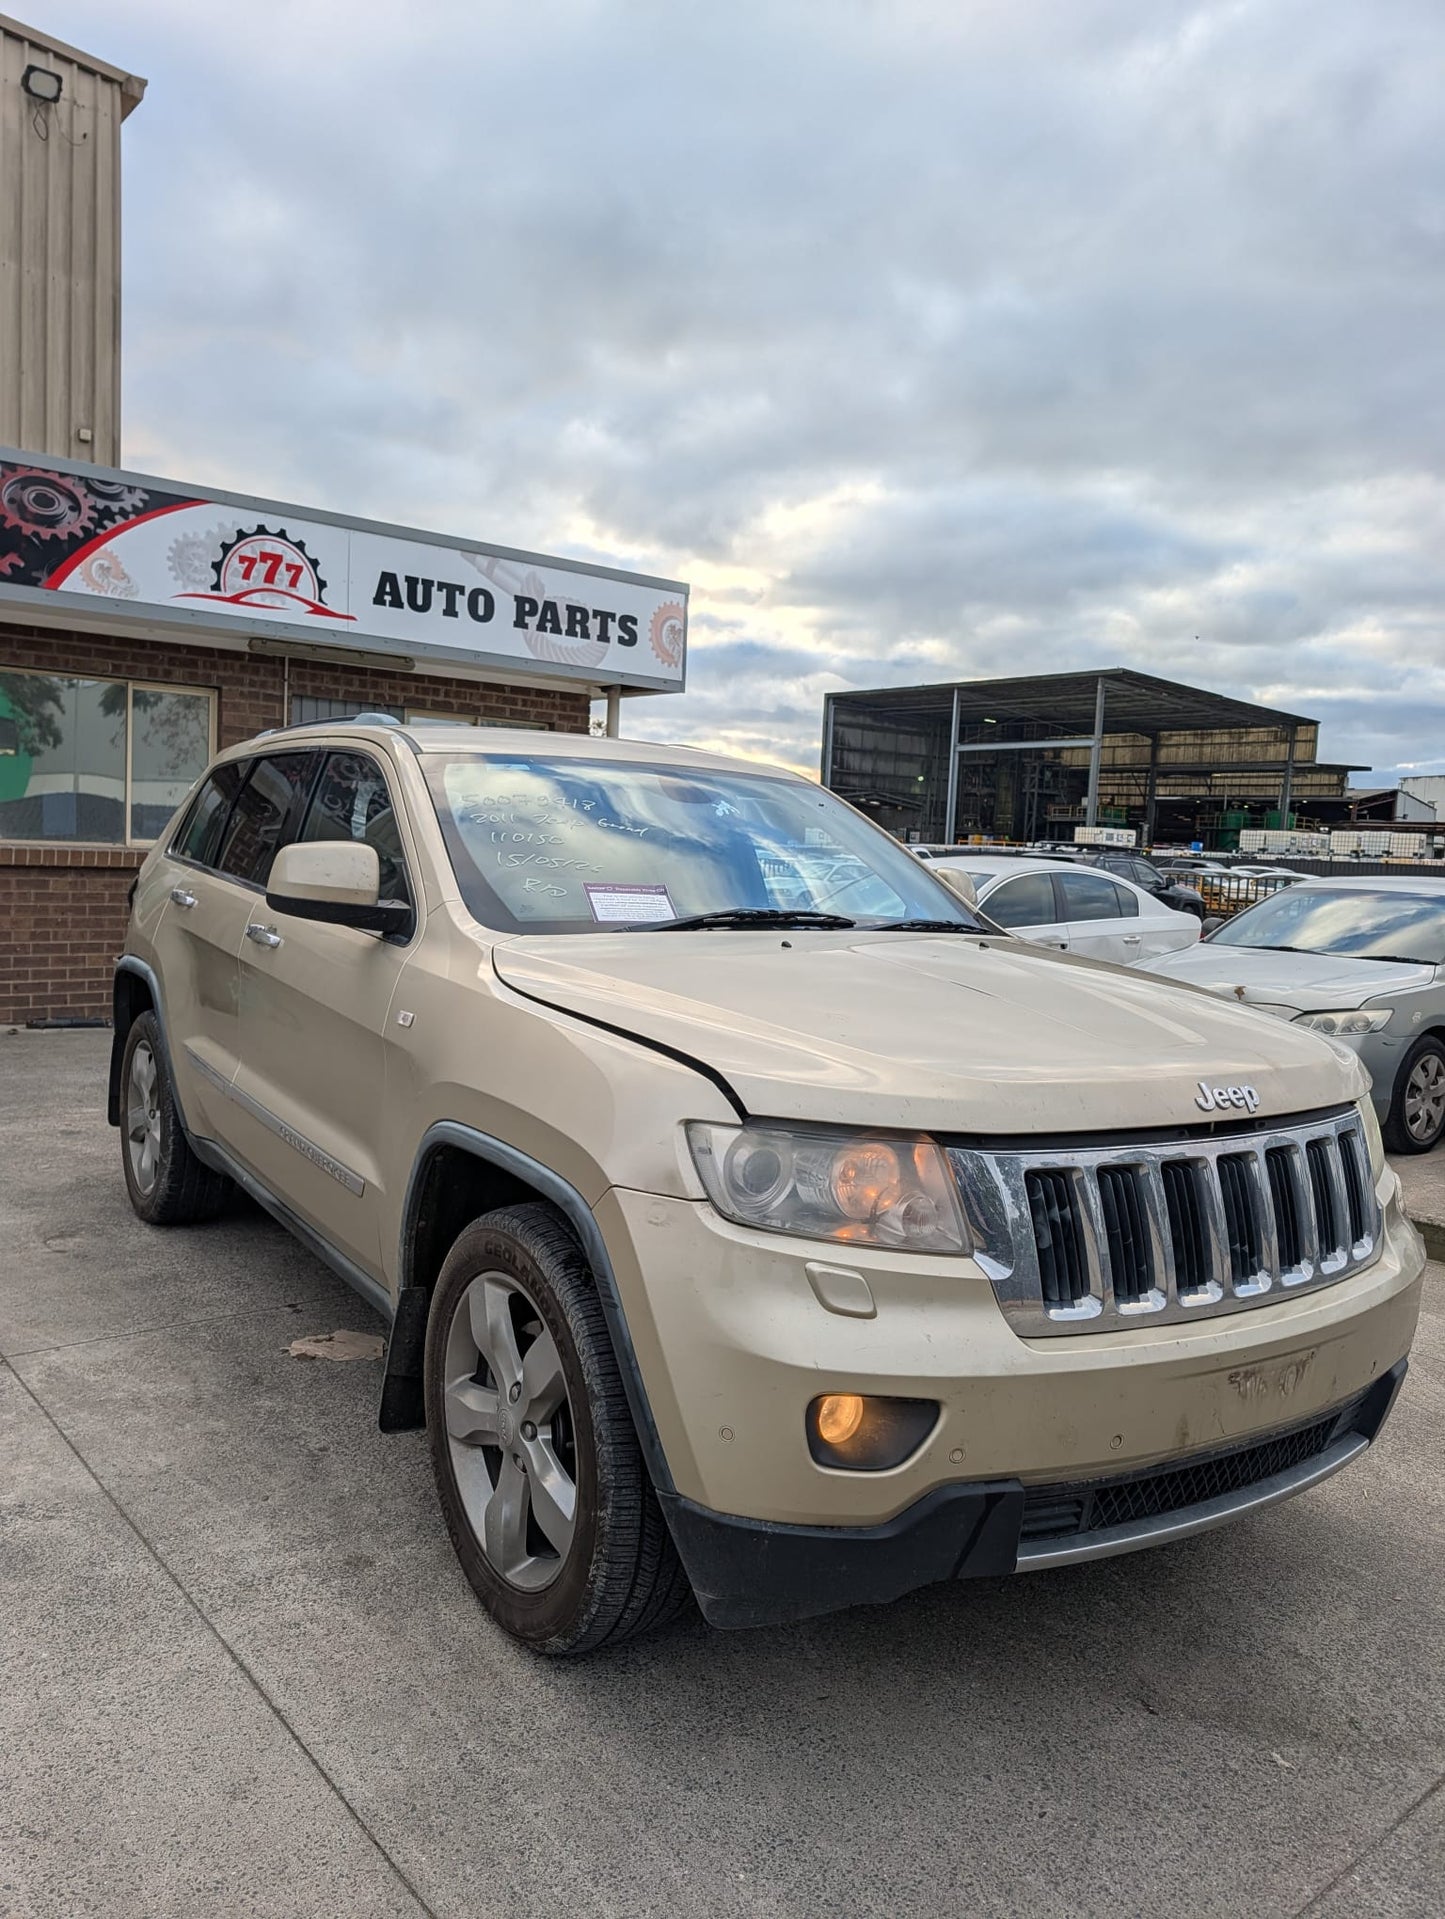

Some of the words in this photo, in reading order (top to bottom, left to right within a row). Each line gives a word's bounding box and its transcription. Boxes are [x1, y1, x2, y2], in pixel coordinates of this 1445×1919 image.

[238, 551, 304, 588] 777
[372, 570, 496, 624] AUTO
[512, 594, 639, 648] PARTS
[1194, 1081, 1261, 1115] Jeep
